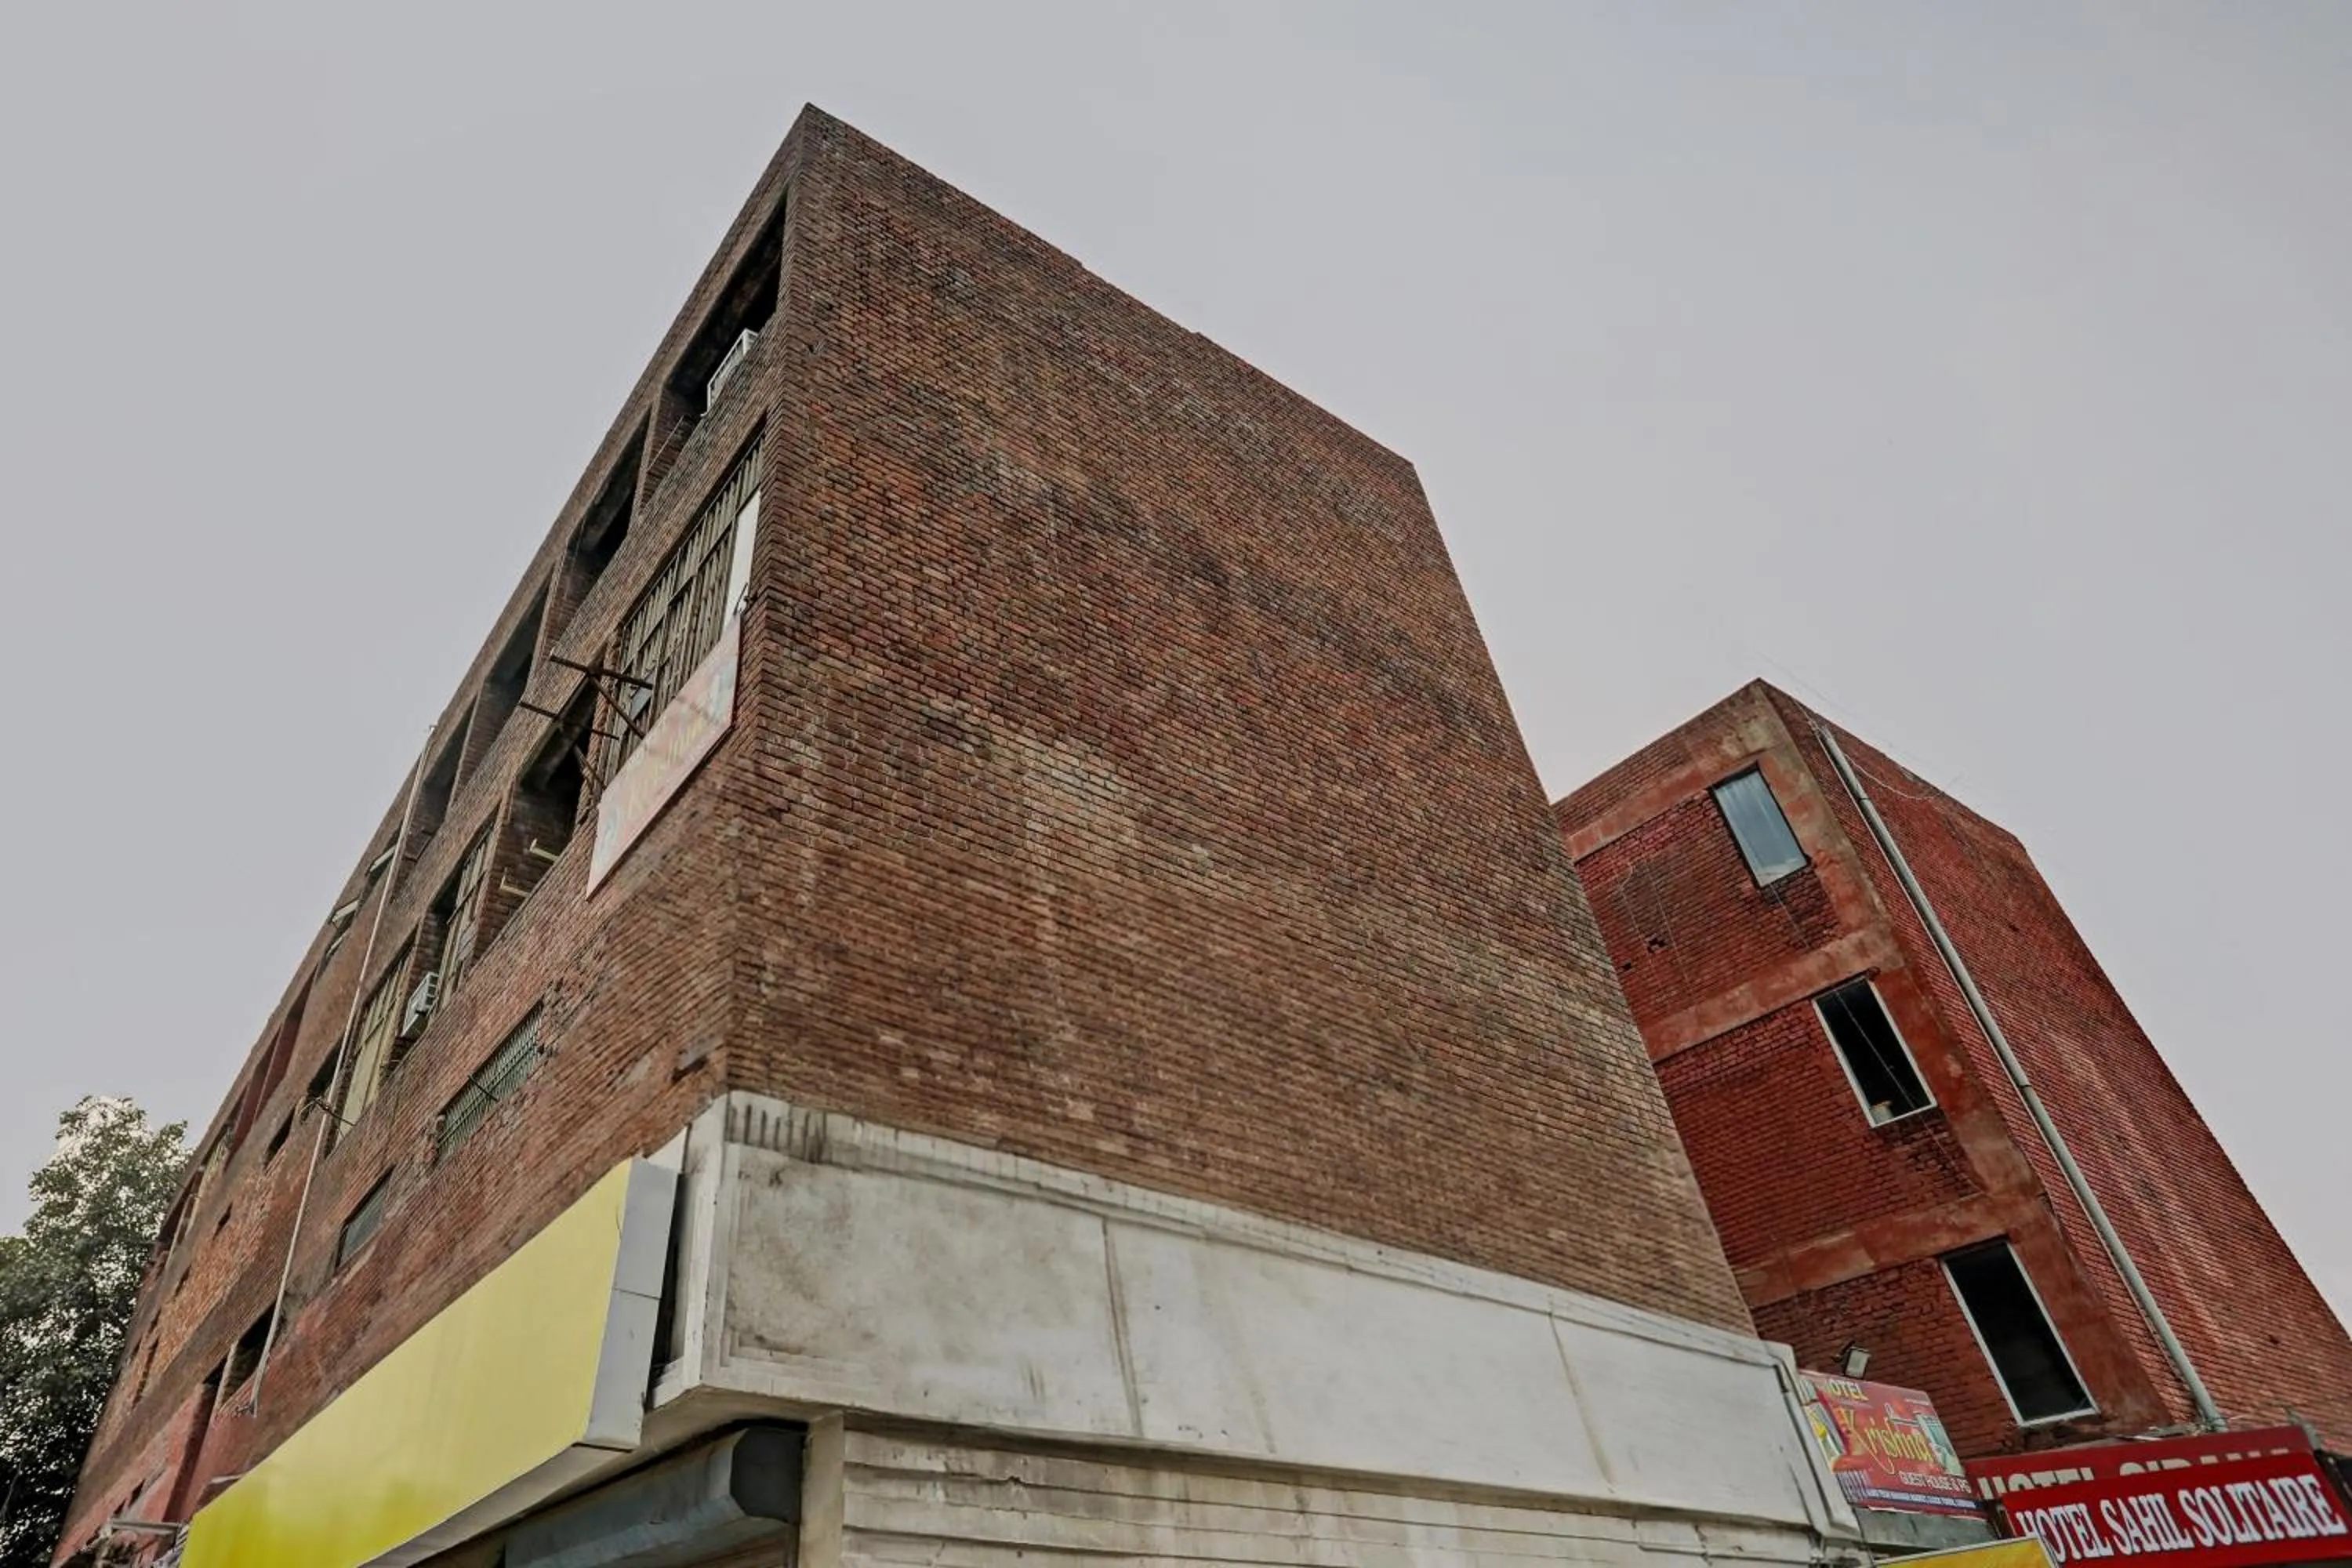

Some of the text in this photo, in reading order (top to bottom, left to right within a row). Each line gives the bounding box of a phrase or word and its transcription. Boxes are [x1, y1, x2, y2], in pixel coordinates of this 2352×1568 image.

[1839, 1408, 1934, 1475] Krishna
[2101, 1492, 2195, 1556] SAHIL
[2179, 1474, 2348, 1548] SOLITAIRE
